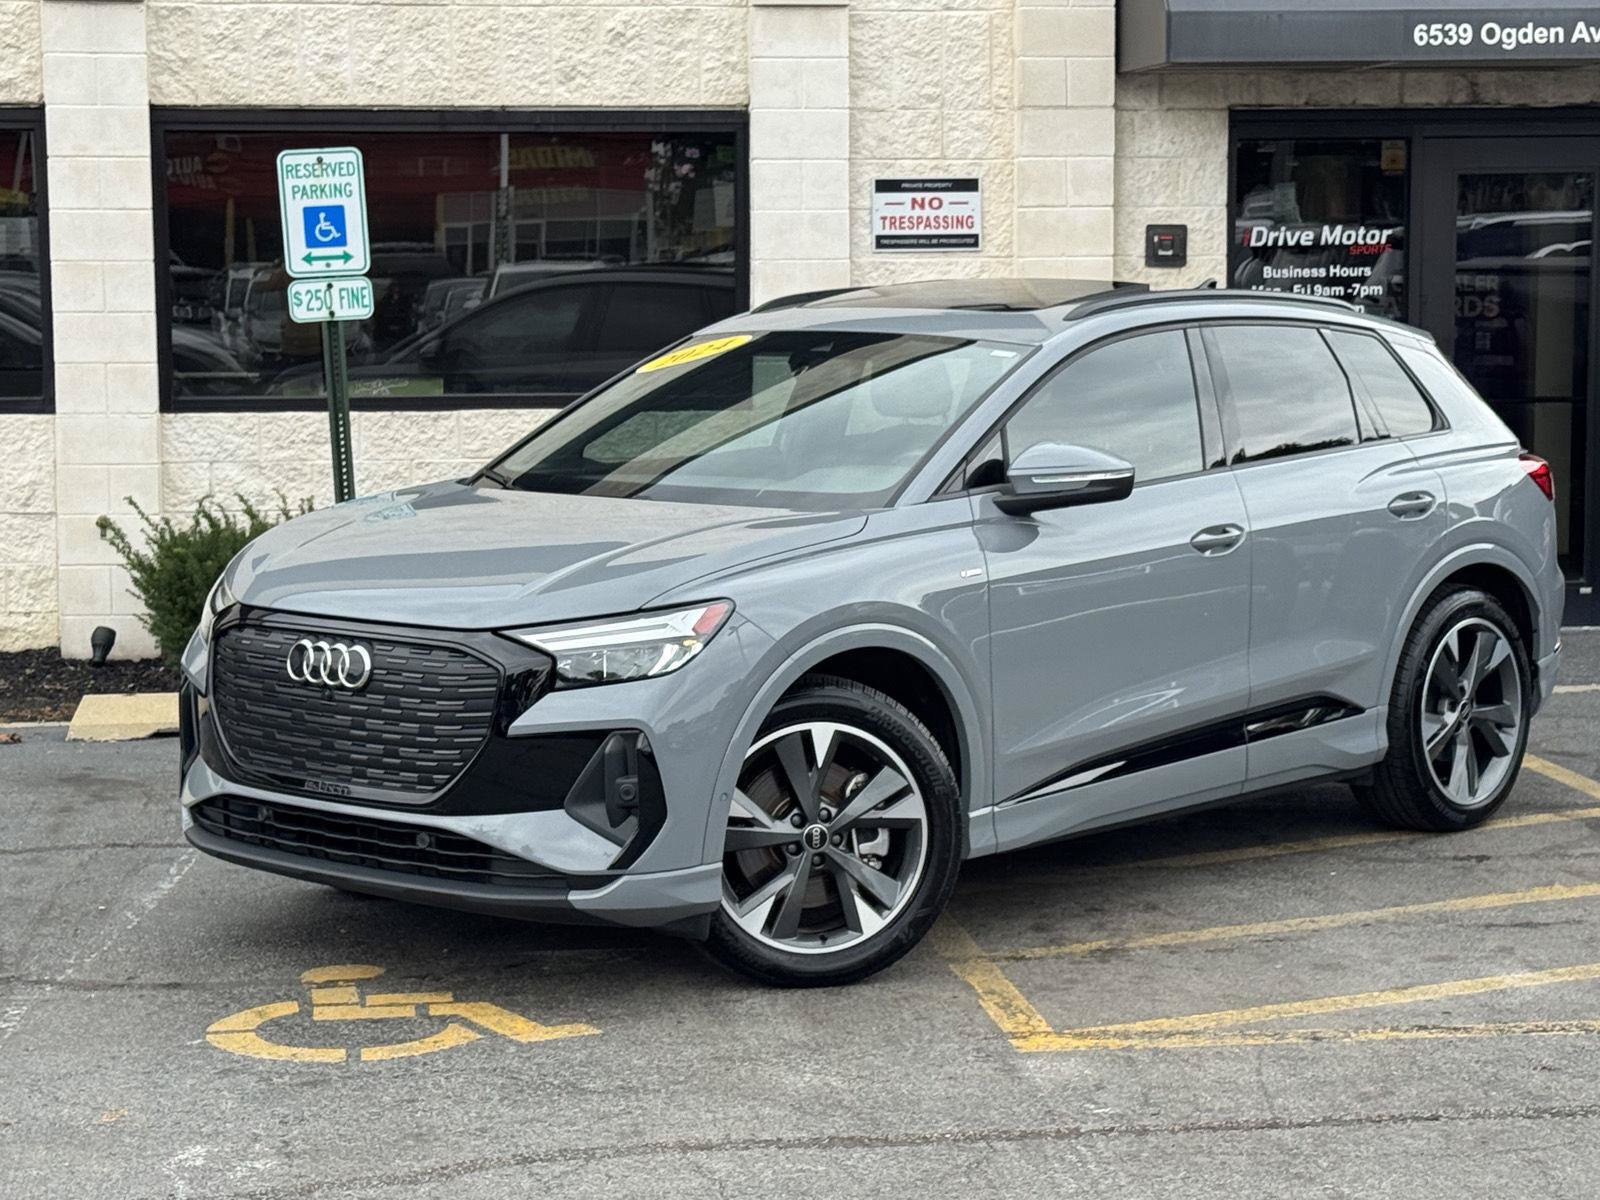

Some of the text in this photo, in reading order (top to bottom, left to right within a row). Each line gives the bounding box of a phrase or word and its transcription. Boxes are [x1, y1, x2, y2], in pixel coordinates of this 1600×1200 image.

[1413, 23, 1473, 46] 6539
[1480, 22, 1564, 50] Ogden
[285, 161, 356, 180] RESERVED
[291, 182, 354, 200] PARKING
[911, 197, 944, 210] NO
[880, 215, 975, 230] TRESPASSING
[1242, 224, 1393, 247] iDrive Motor
[1350, 244, 1393, 255] SPORTS
[1263, 264, 1372, 279] Business Hours
[1314, 284, 1345, 297] 9am
[293, 286, 370, 312] $250 FINE
